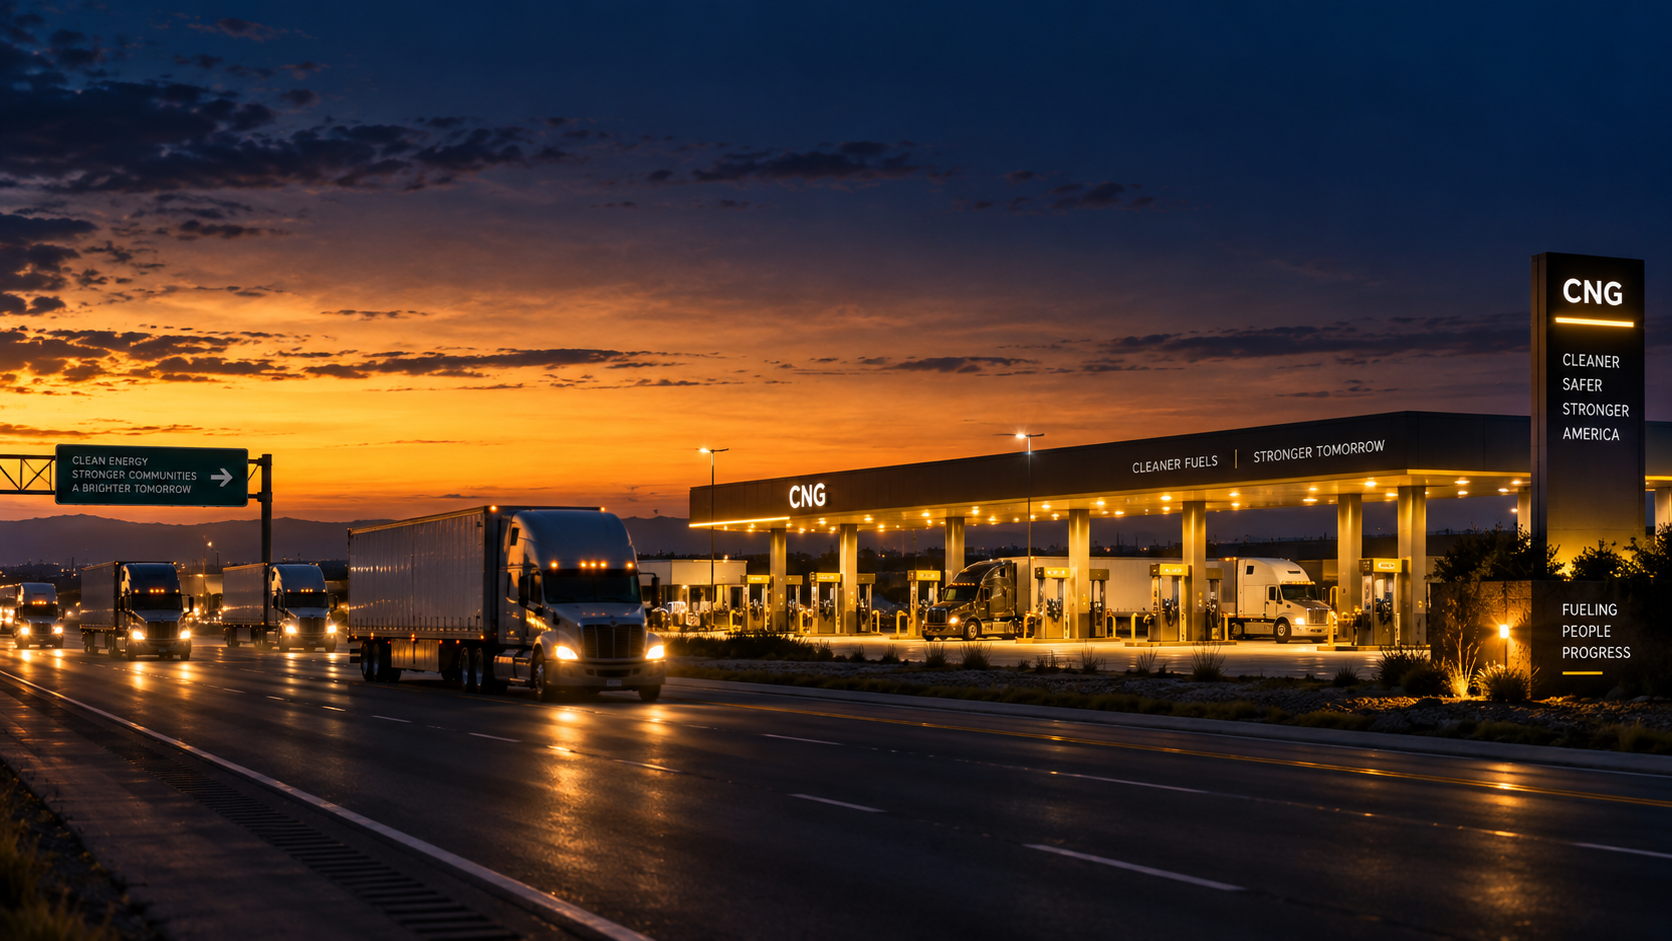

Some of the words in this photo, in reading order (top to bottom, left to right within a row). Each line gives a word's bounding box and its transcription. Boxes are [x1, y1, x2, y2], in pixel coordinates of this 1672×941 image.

[1562, 277, 1623, 306] CNG
[1562, 353, 1620, 368] CLEANER
[1562, 377, 1603, 392] SAFER
[1562, 402, 1630, 417] STRONGER
[1562, 426, 1620, 441] AMERICA
[71, 455, 106, 465] CLEAN
[108, 456, 149, 466] ENERGY
[1132, 458, 1181, 473] CLEANER
[1185, 454, 1218, 469] FUELS
[1253, 446, 1313, 463] STRONGER
[1316, 439, 1386, 456] TOMORROW
[72, 469, 126, 480] STRONGER
[129, 471, 197, 481] COMMUNITIES
[72, 483, 80, 492] A
[83, 484, 131, 493] BRIGHTER
[135, 485, 192, 494] TOMORROW
[789, 482, 827, 509] CNG
[1562, 603, 1618, 617] FUELING
[1562, 624, 1612, 638] PEOPLE
[1562, 646, 1631, 659] PROGRESS
